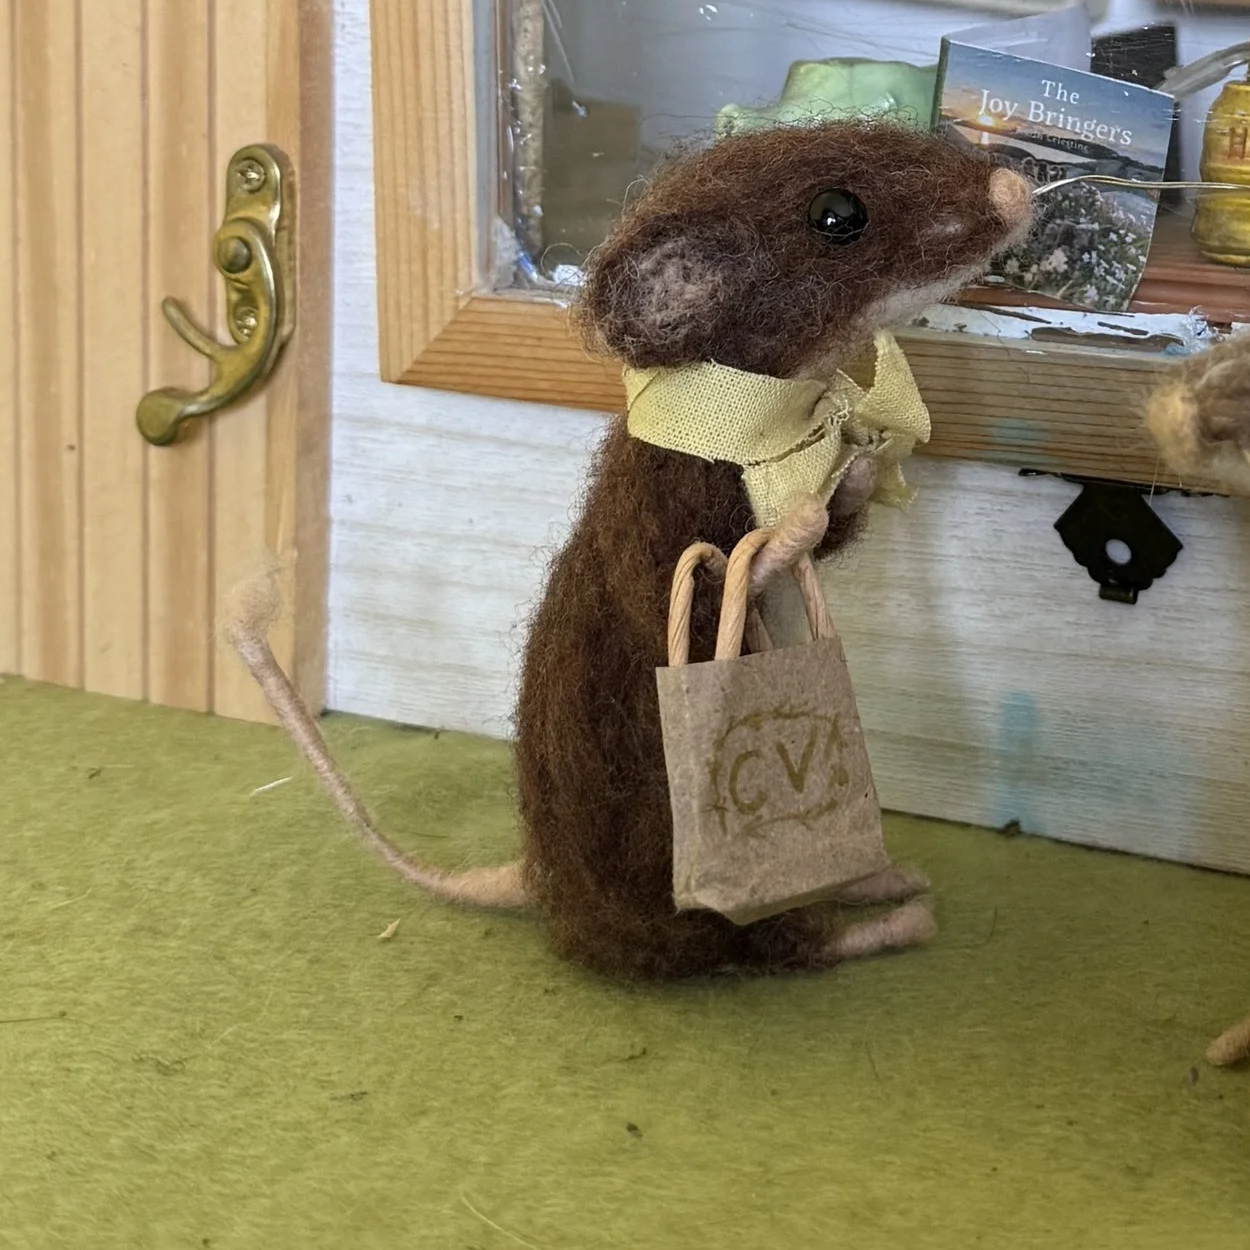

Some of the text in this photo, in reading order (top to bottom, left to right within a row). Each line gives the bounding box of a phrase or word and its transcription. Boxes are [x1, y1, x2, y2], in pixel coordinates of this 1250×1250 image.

[1041, 79, 1080, 105] The
[978, 89, 1133, 146] Joy Bringers
